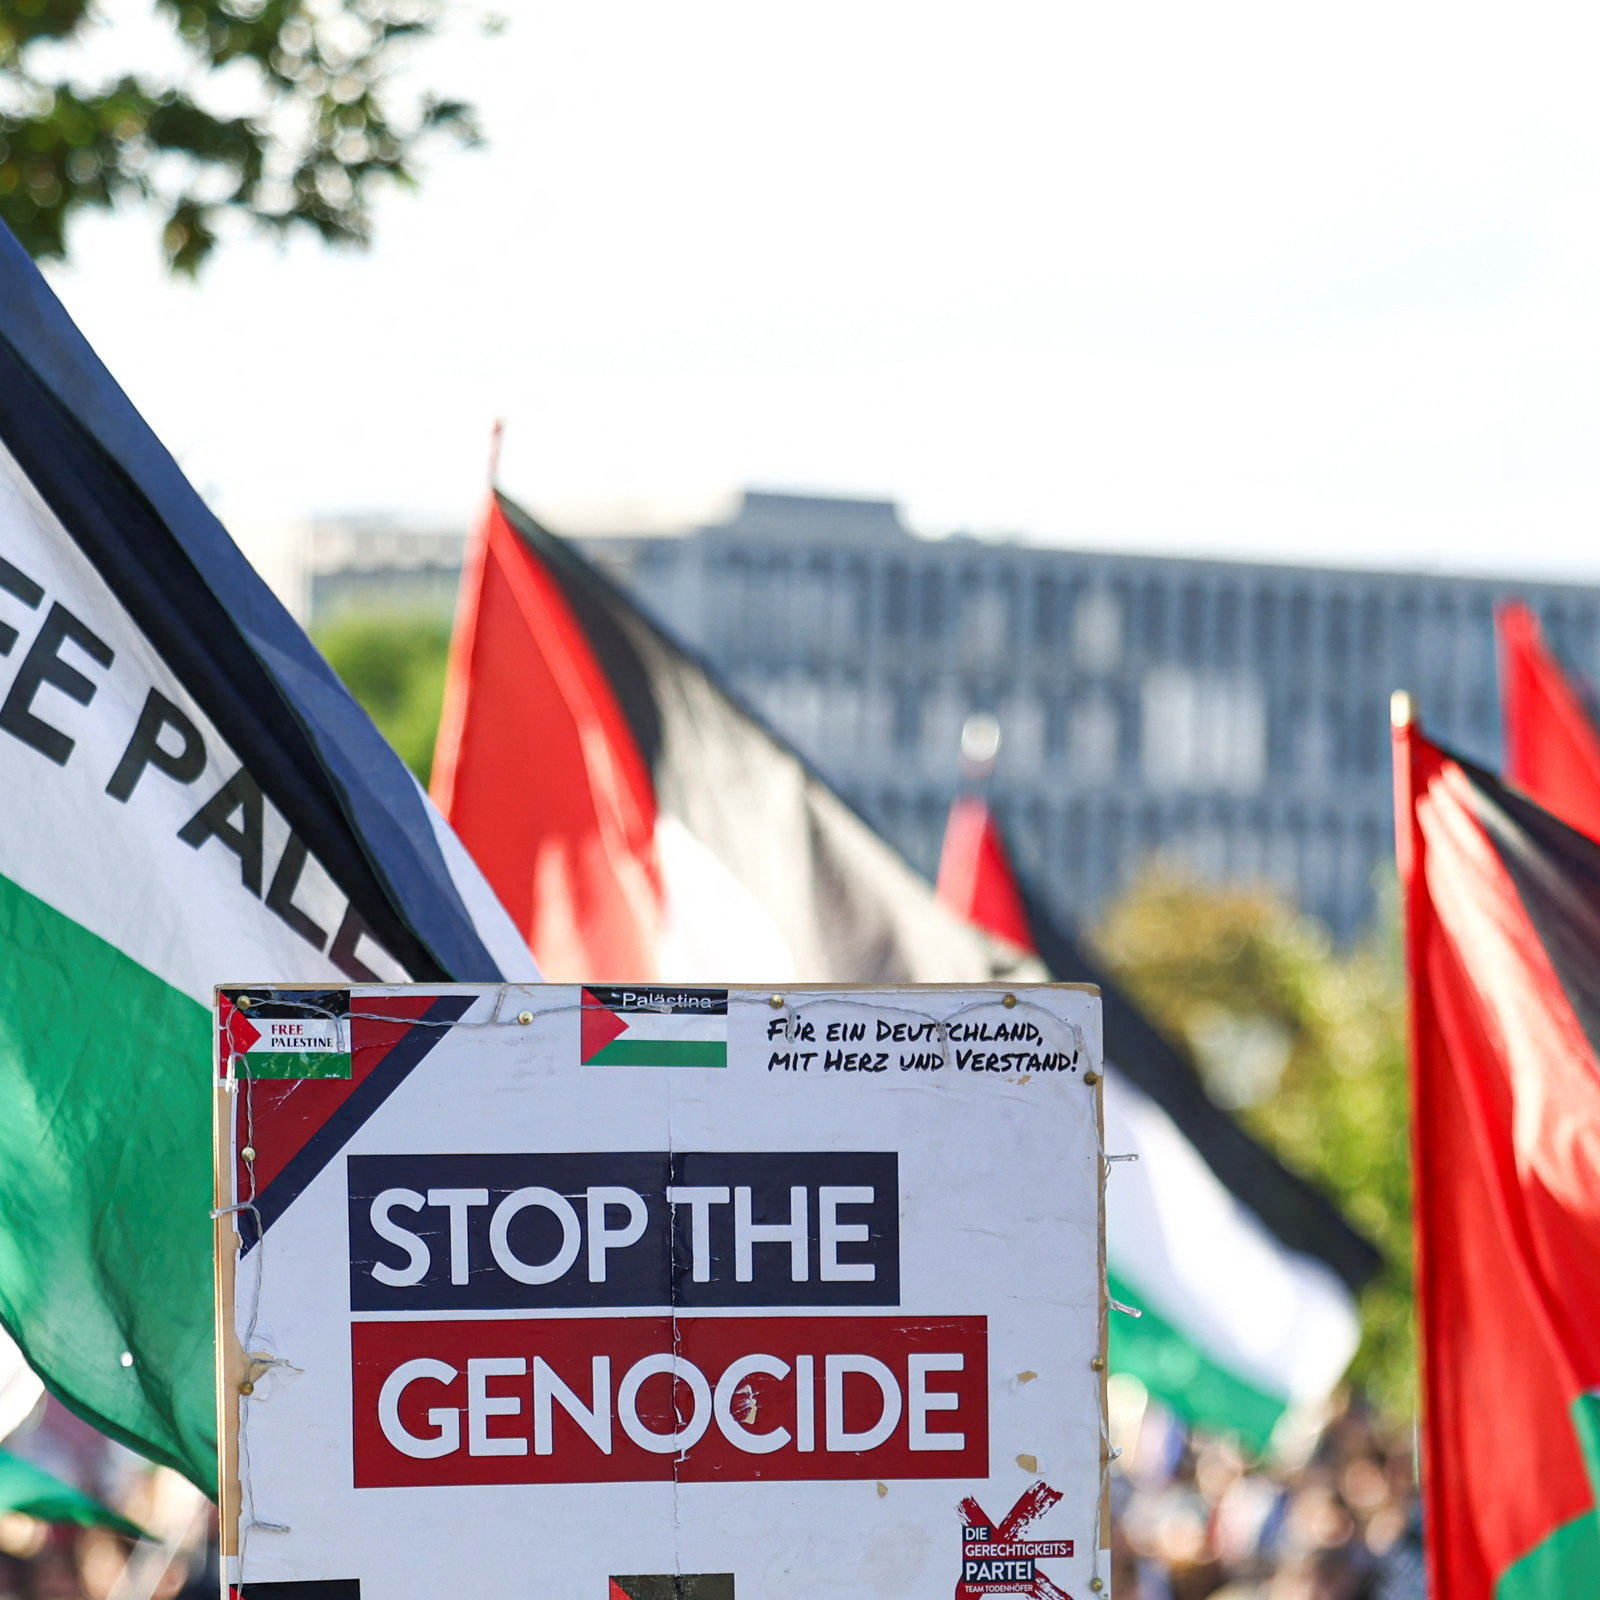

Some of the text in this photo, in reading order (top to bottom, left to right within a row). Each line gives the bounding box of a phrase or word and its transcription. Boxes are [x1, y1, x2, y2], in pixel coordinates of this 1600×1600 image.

[270, 1024, 304, 1036] FREE
[767, 1014, 1043, 1047] FÜR EIN DEUTCHLAND,
[270, 1037, 334, 1048] PALESTINE
[768, 1049, 1079, 1073] MIT HERZ UND VERSTAND!
[369, 1185, 876, 1287] STOP THE
[378, 1353, 966, 1459] GENOCIDE
[965, 1527, 988, 1541] DIE
[965, 1543, 1071, 1557] GERECHTIGKEITS-
[966, 1561, 1032, 1581] PARTEI
[965, 1583, 1034, 1593] TEAM TODENHÖFER
